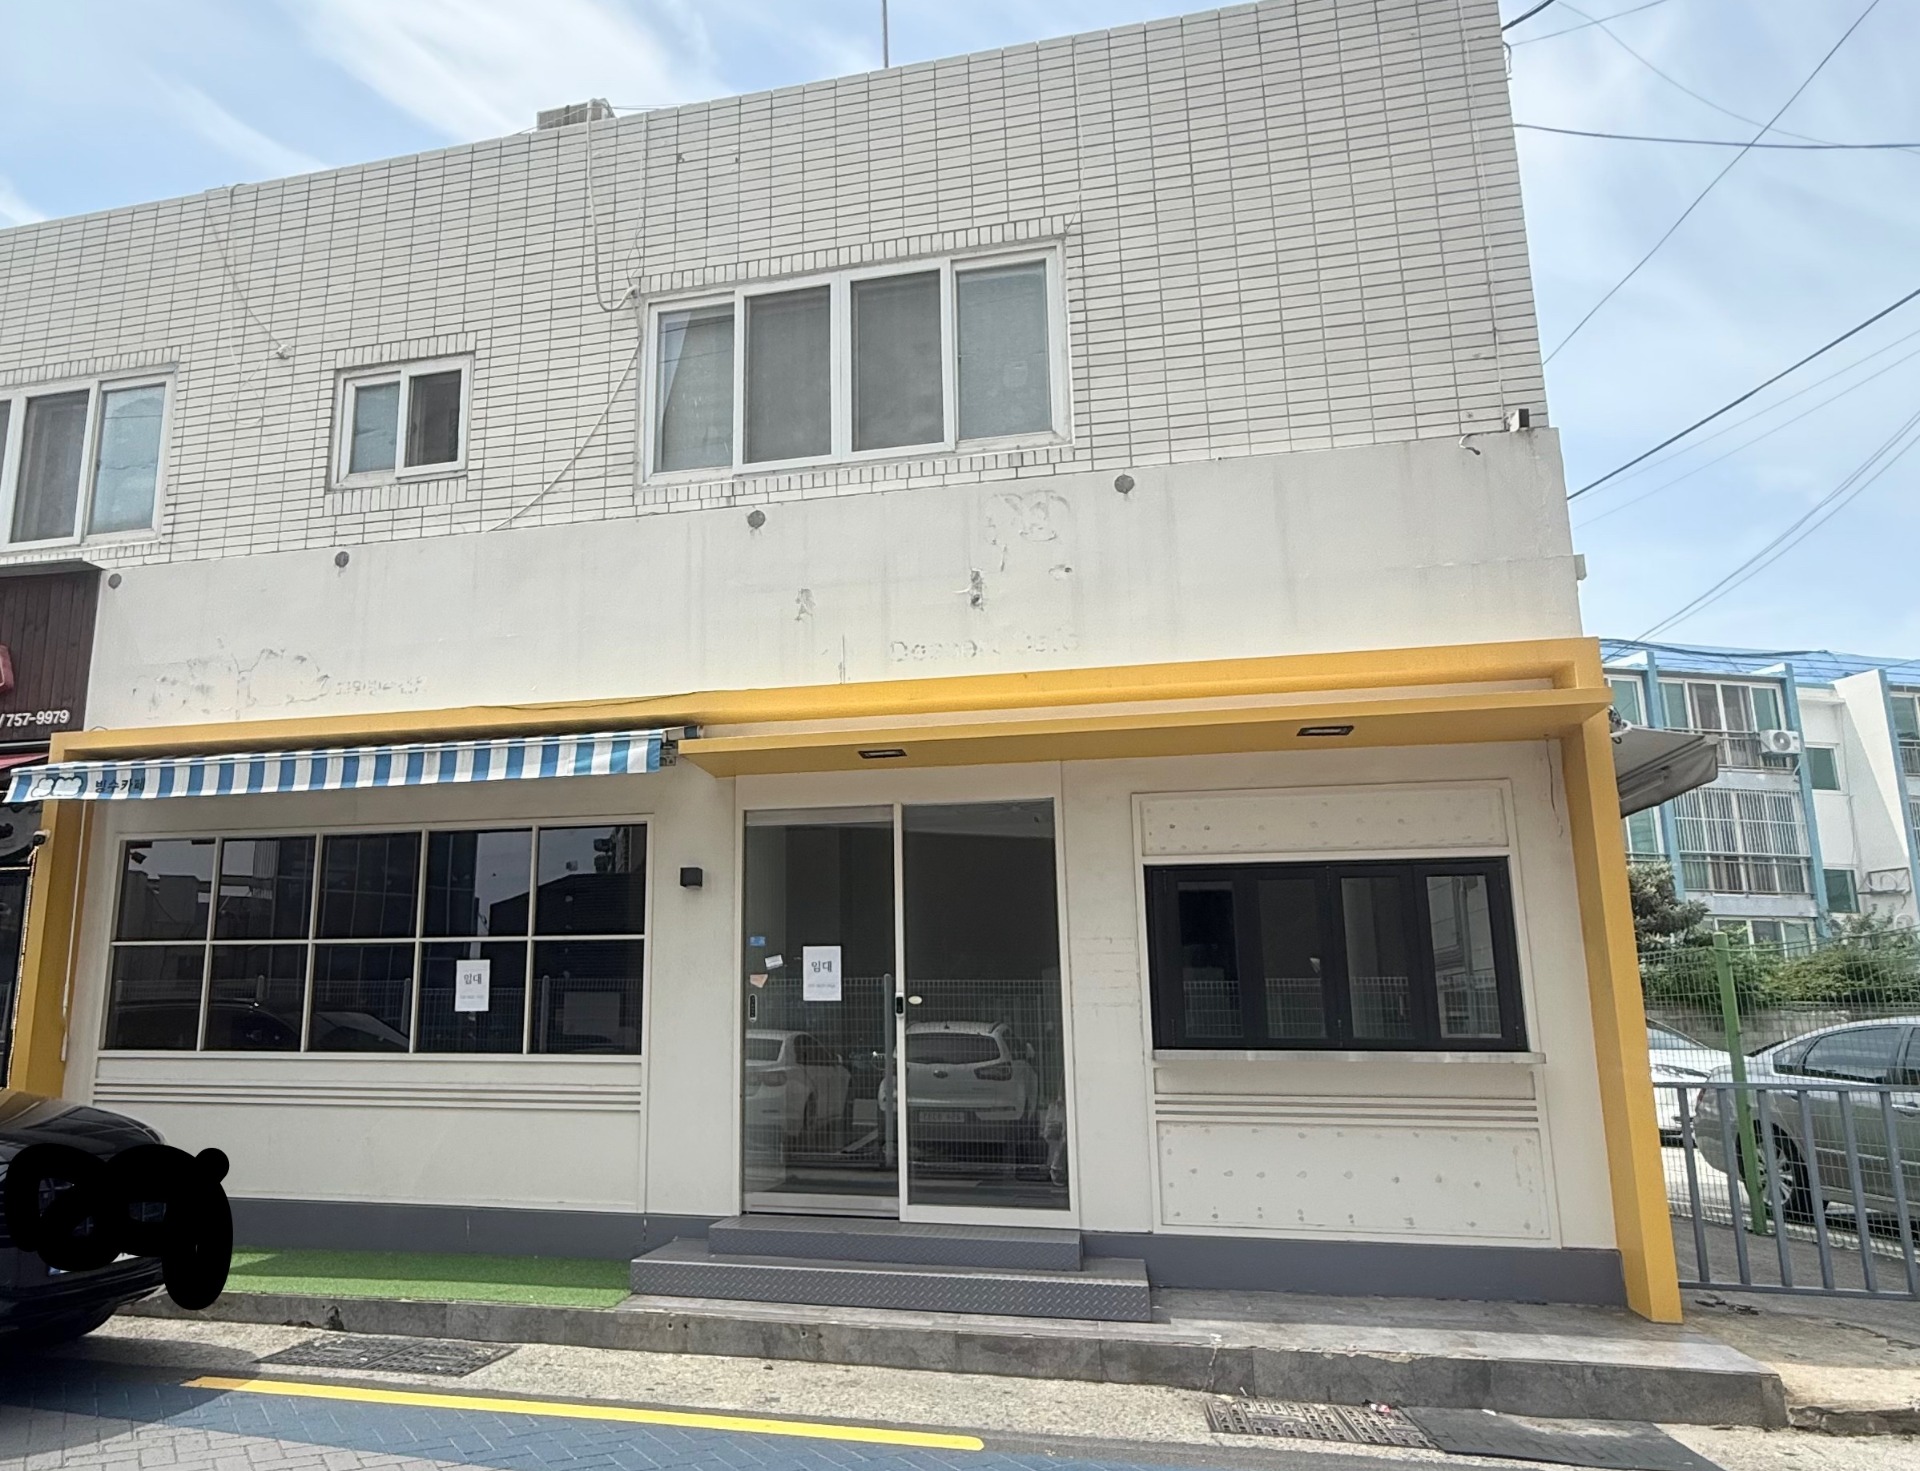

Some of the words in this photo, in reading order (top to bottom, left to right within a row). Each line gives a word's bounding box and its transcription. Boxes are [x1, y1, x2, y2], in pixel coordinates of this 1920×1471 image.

[95, 779, 145, 793] 빙수카페
[810, 960, 832, 973] 임대
[463, 973, 482, 985] 임대
